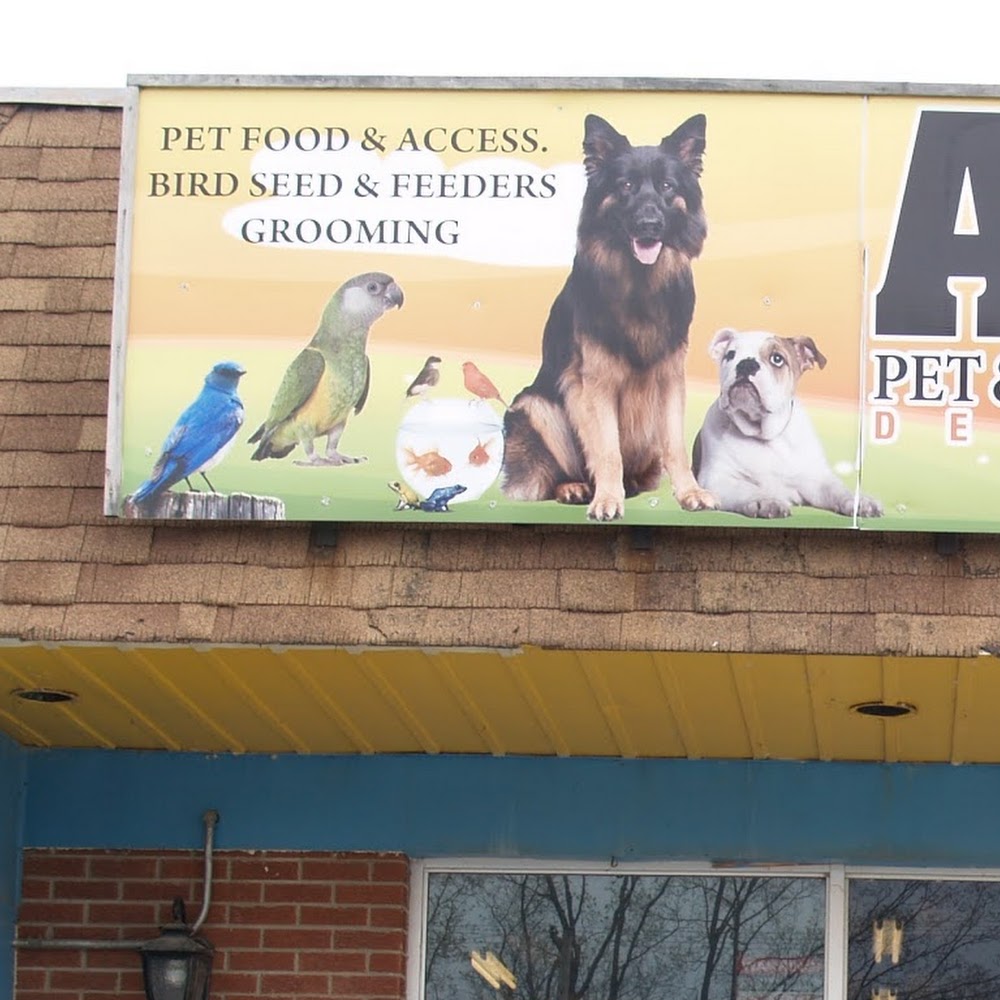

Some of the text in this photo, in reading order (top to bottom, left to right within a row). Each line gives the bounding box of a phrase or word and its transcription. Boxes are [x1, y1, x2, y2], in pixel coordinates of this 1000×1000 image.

[161, 126, 548, 153] PET FOOD & ACCESS.
[148, 172, 557, 199] BIRD SEED & FEEDERS
[241, 217, 459, 245] GROOMING
[874, 354, 982, 402] PET
